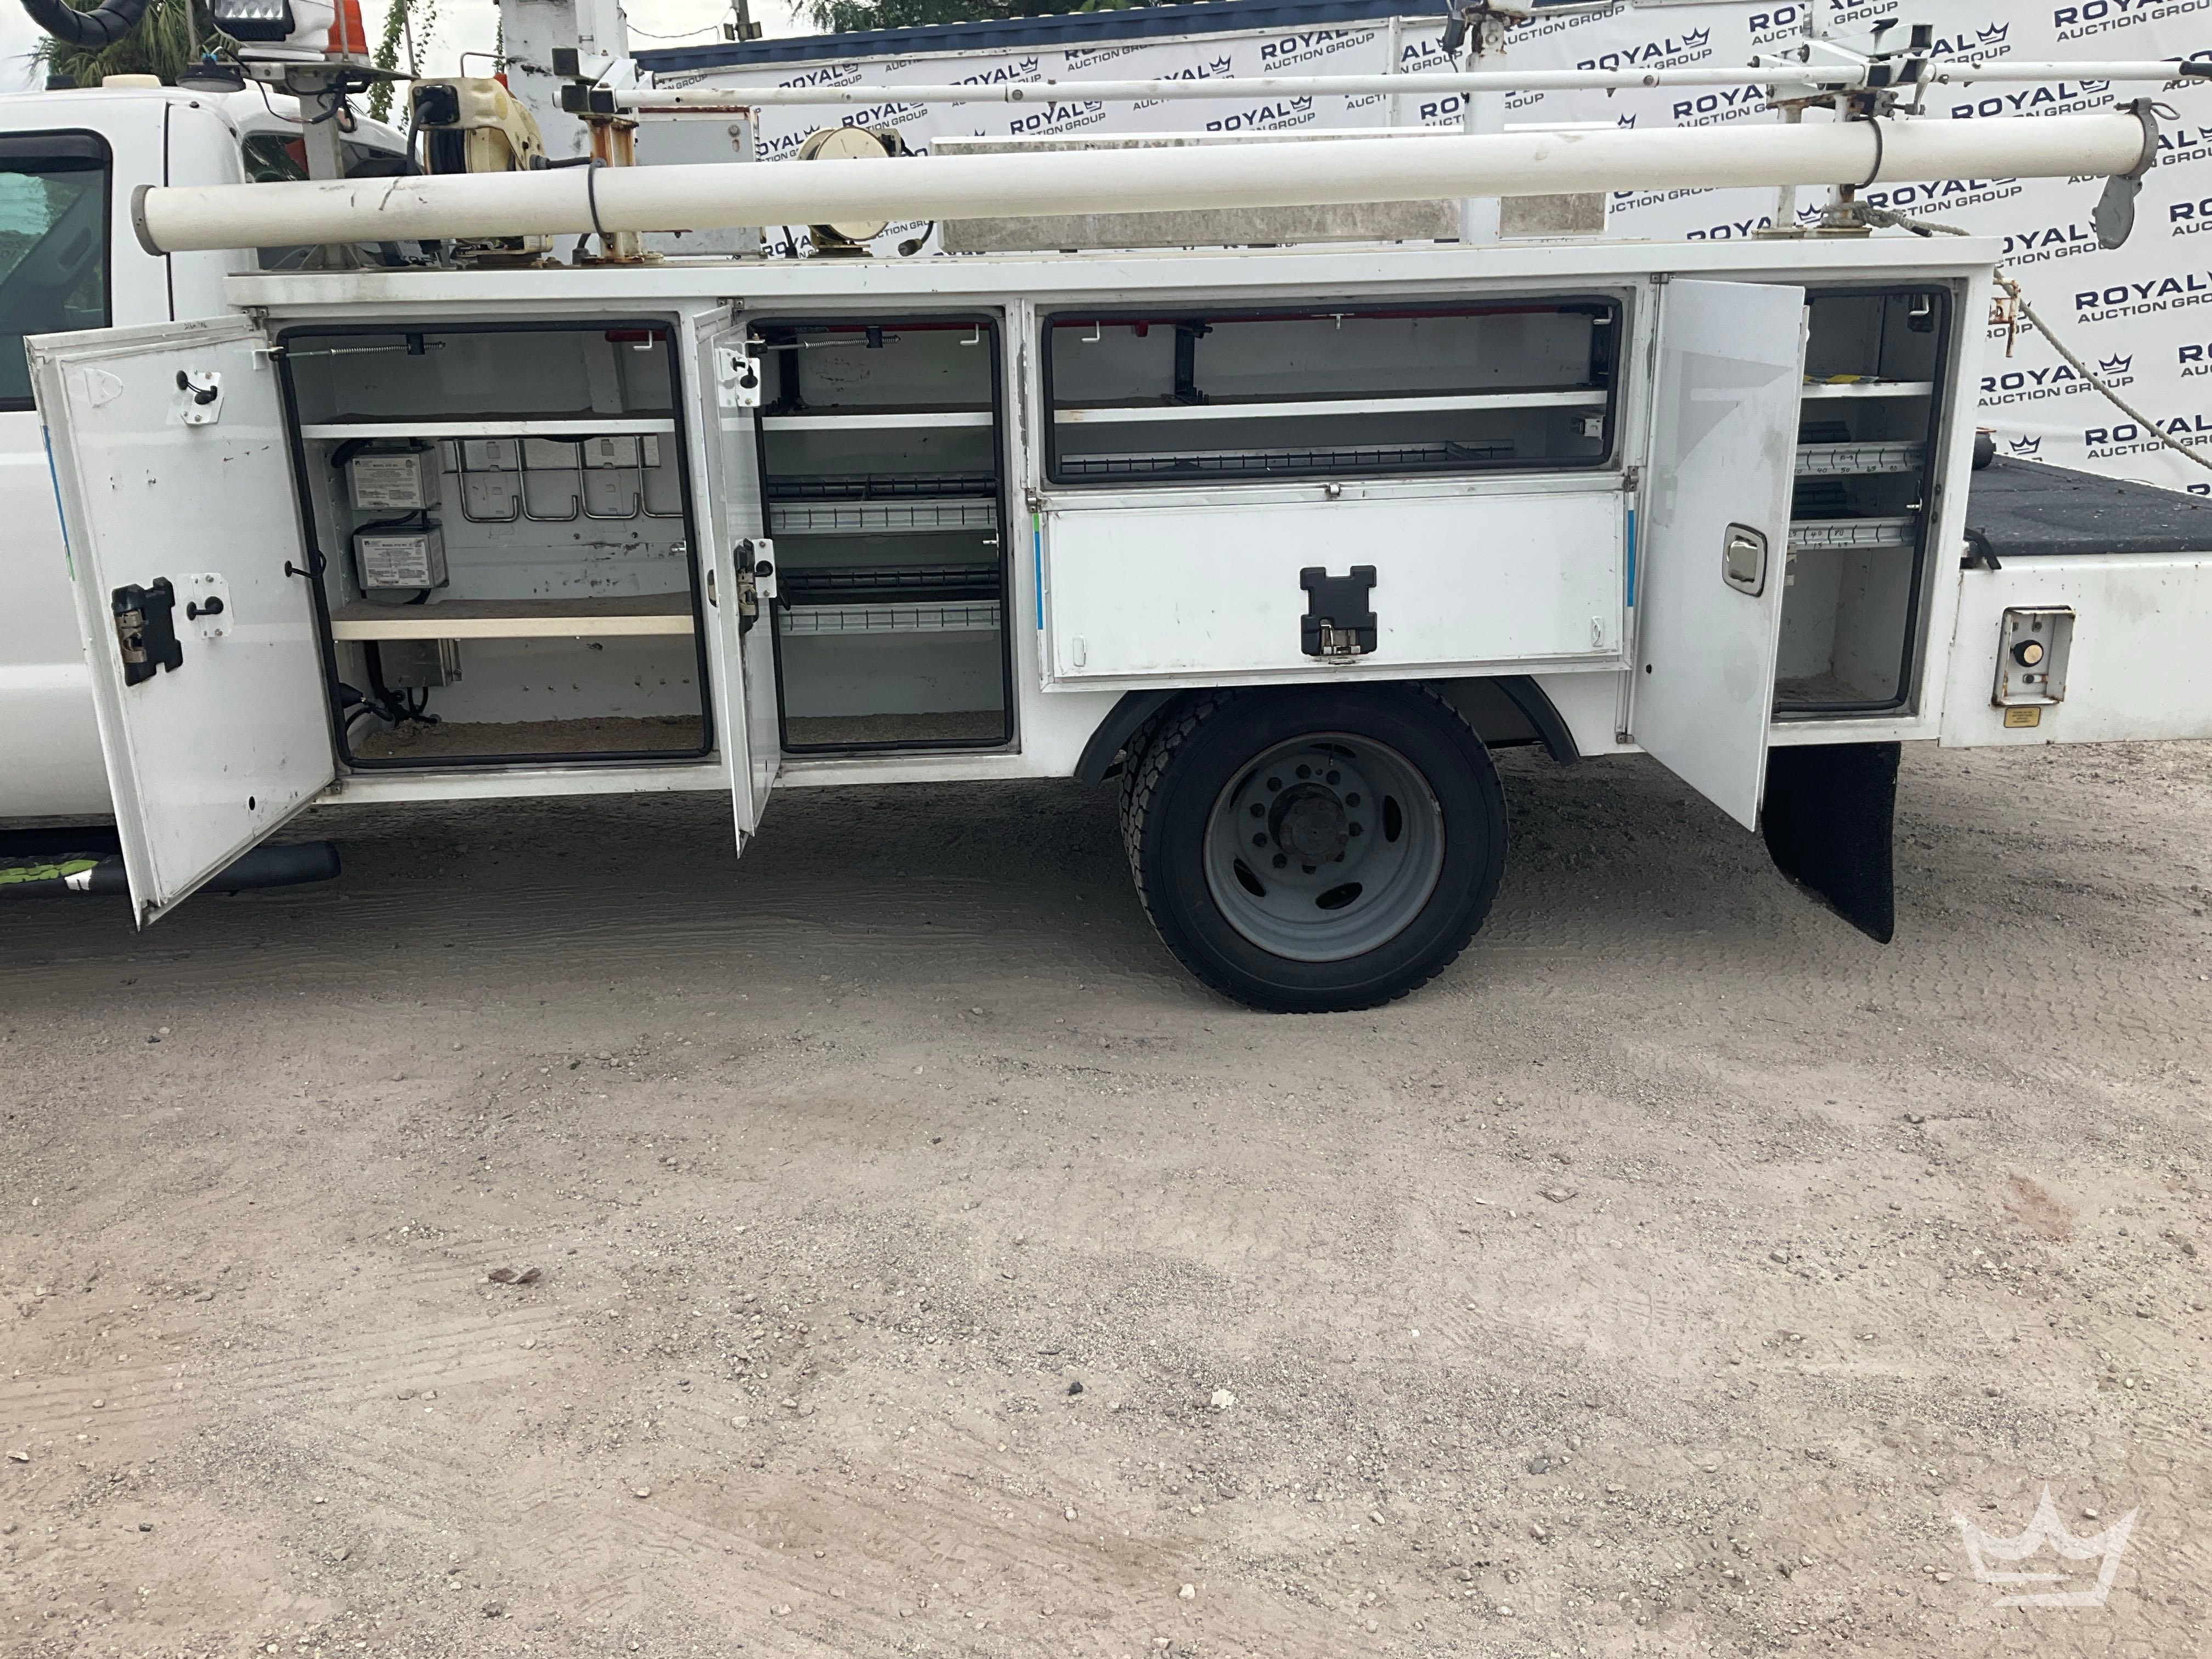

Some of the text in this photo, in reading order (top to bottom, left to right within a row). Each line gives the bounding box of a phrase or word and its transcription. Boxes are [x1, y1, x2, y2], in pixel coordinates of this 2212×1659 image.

[1569, 5, 1625, 28] GROUP
[1834, 2, 1898, 25] GROUP
[2055, 0, 2172, 27] ROY
[2057, 0, 2211, 42] AUCTION GROU
[1261, 30, 1348, 60] ROYAL
[1752, 25, 1804, 46] AUCTI
[1068, 48, 1120, 72] AUCTION
[1264, 48, 1323, 72] AUCTION
[1326, 32, 1375, 54] GROUP
[1412, 50, 1463, 71] GROUP
[1655, 48, 1712, 69] GROUP
[676, 74, 708, 89] GROUP
[949, 65, 1020, 85] OYAL
[1346, 94, 1386, 110] AUCTI
[1505, 93, 1544, 110] ROUP
[1673, 84, 1764, 119] ROYA
[1951, 82, 2078, 119] ROYAL
[2045, 94, 2115, 117] GROUP
[842, 103, 908, 127] ROYAL
[891, 109, 928, 126] GROUP
[1010, 103, 1084, 134] ROYAL
[1065, 112, 1106, 131] GROUP
[1206, 103, 1290, 131] ROYAL
[1268, 112, 1315, 131] GROUP
[759, 133, 805, 156] OYAL
[1609, 193, 1665, 214] CTION
[1867, 179, 1988, 208] ROYAL
[1903, 186, 2023, 218] TION GROUP
[1687, 216, 1771, 240] OYA
[2002, 224, 2089, 254] YAL
[2055, 241, 2107, 258] GRO
[2075, 274, 2207, 310] ROYAL
[2078, 293, 2212, 324] AUCTION GRO
[1978, 376, 2134, 407] AUCTION GRUP
